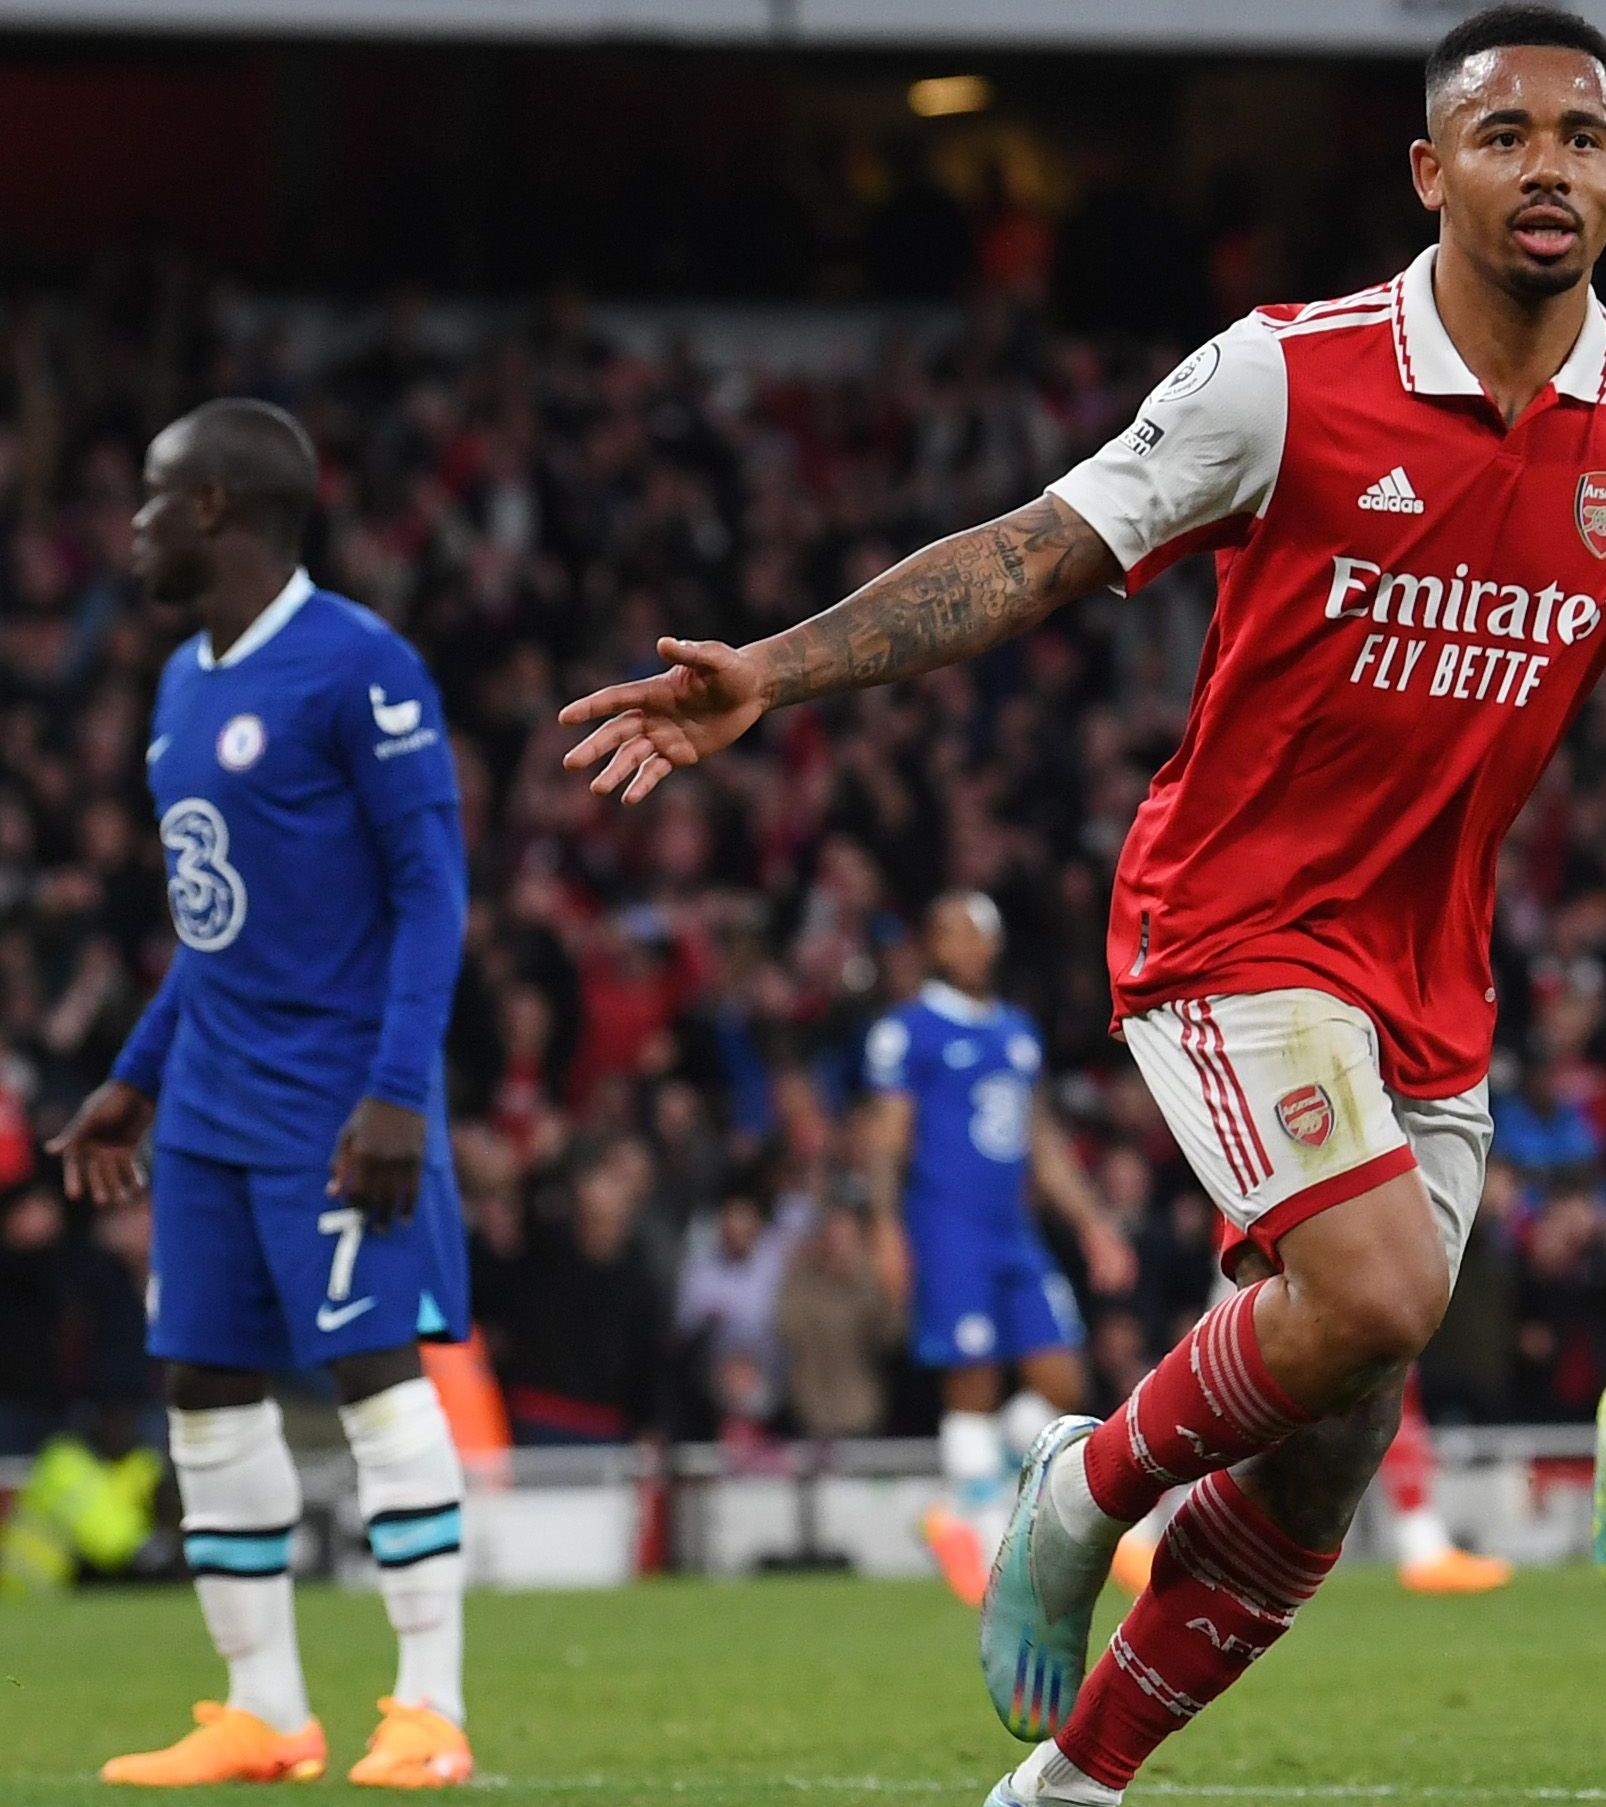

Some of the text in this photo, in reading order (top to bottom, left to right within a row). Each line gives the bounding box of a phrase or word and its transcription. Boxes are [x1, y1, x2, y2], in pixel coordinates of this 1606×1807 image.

[1358, 491, 1424, 514] adidas
[1350, 634, 1550, 708] FLY BETTE
[160, 797, 249, 953] 3
[317, 1207, 365, 1302] 7
